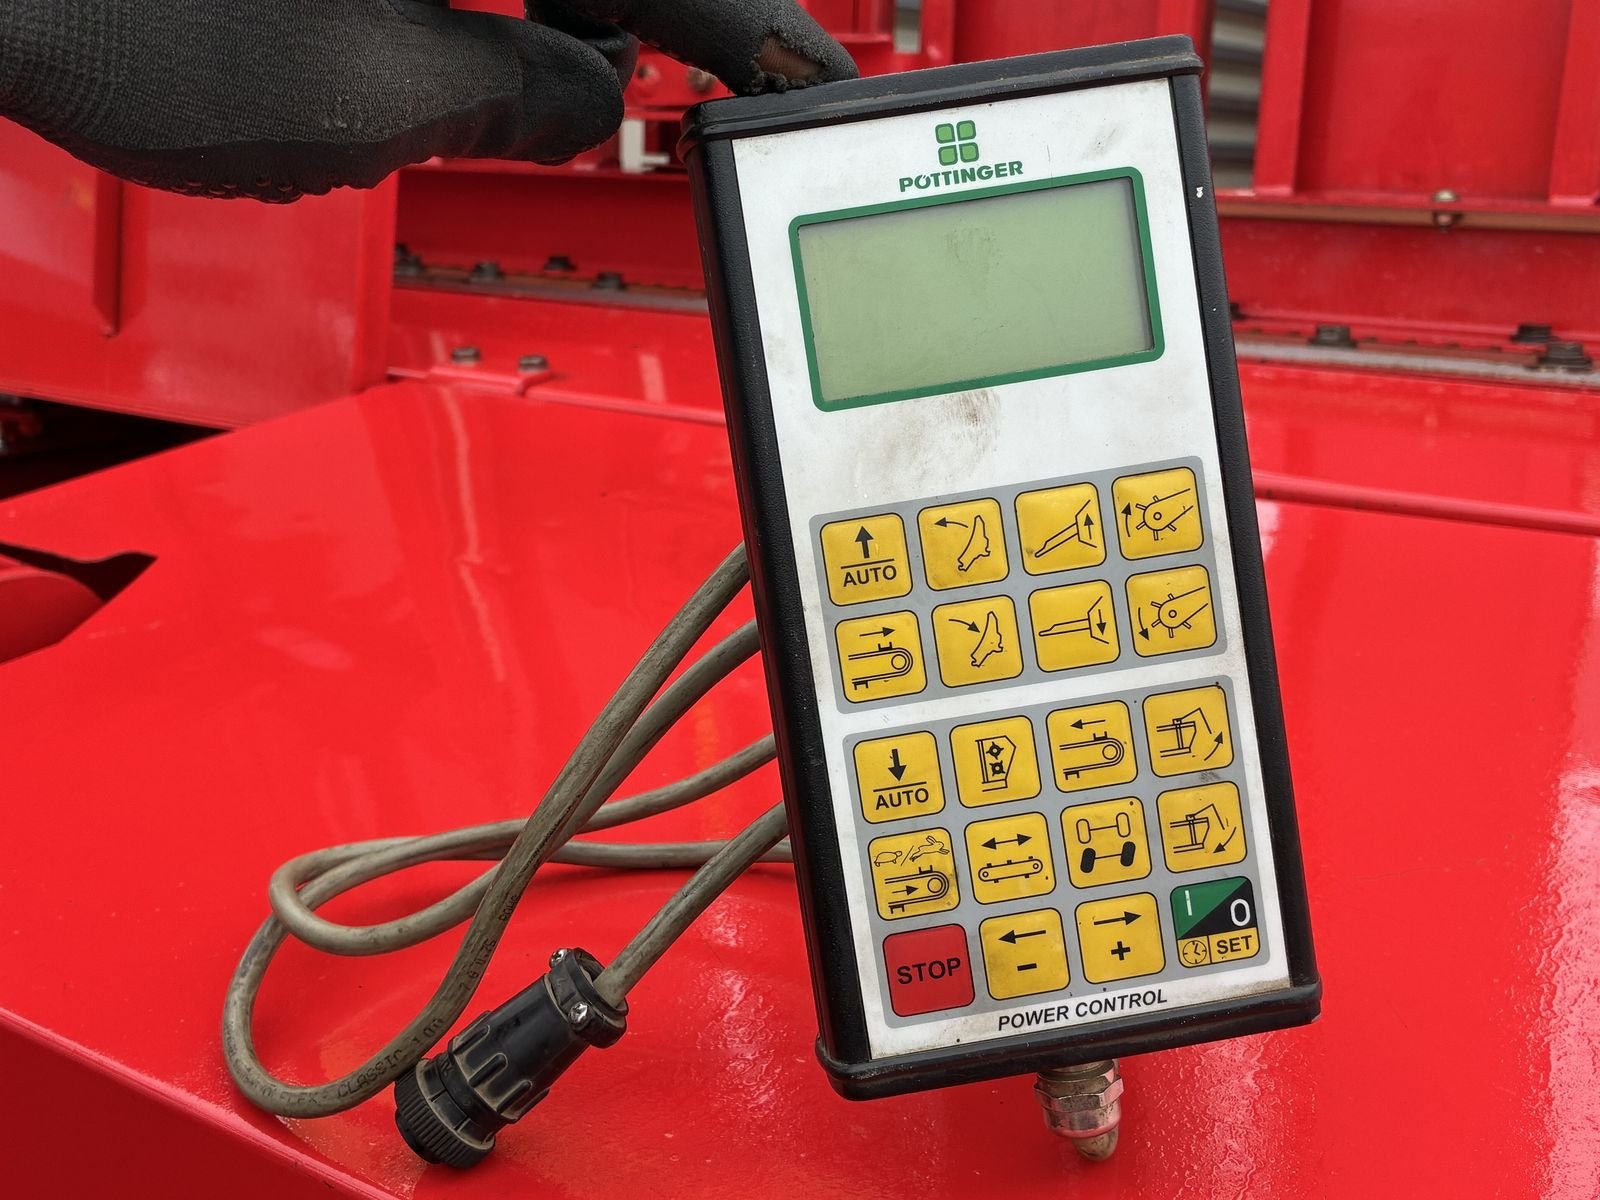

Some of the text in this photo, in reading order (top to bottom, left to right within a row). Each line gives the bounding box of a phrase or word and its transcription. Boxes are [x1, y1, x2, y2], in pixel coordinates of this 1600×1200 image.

[842, 563, 898, 588] AUTO
[874, 786, 930, 811] AUTO
[1216, 934, 1253, 955] SET
[896, 957, 962, 986] STOP
[998, 988, 1168, 1032] POWER CONTROL
[337, 1049, 408, 1098] CLASSIC
